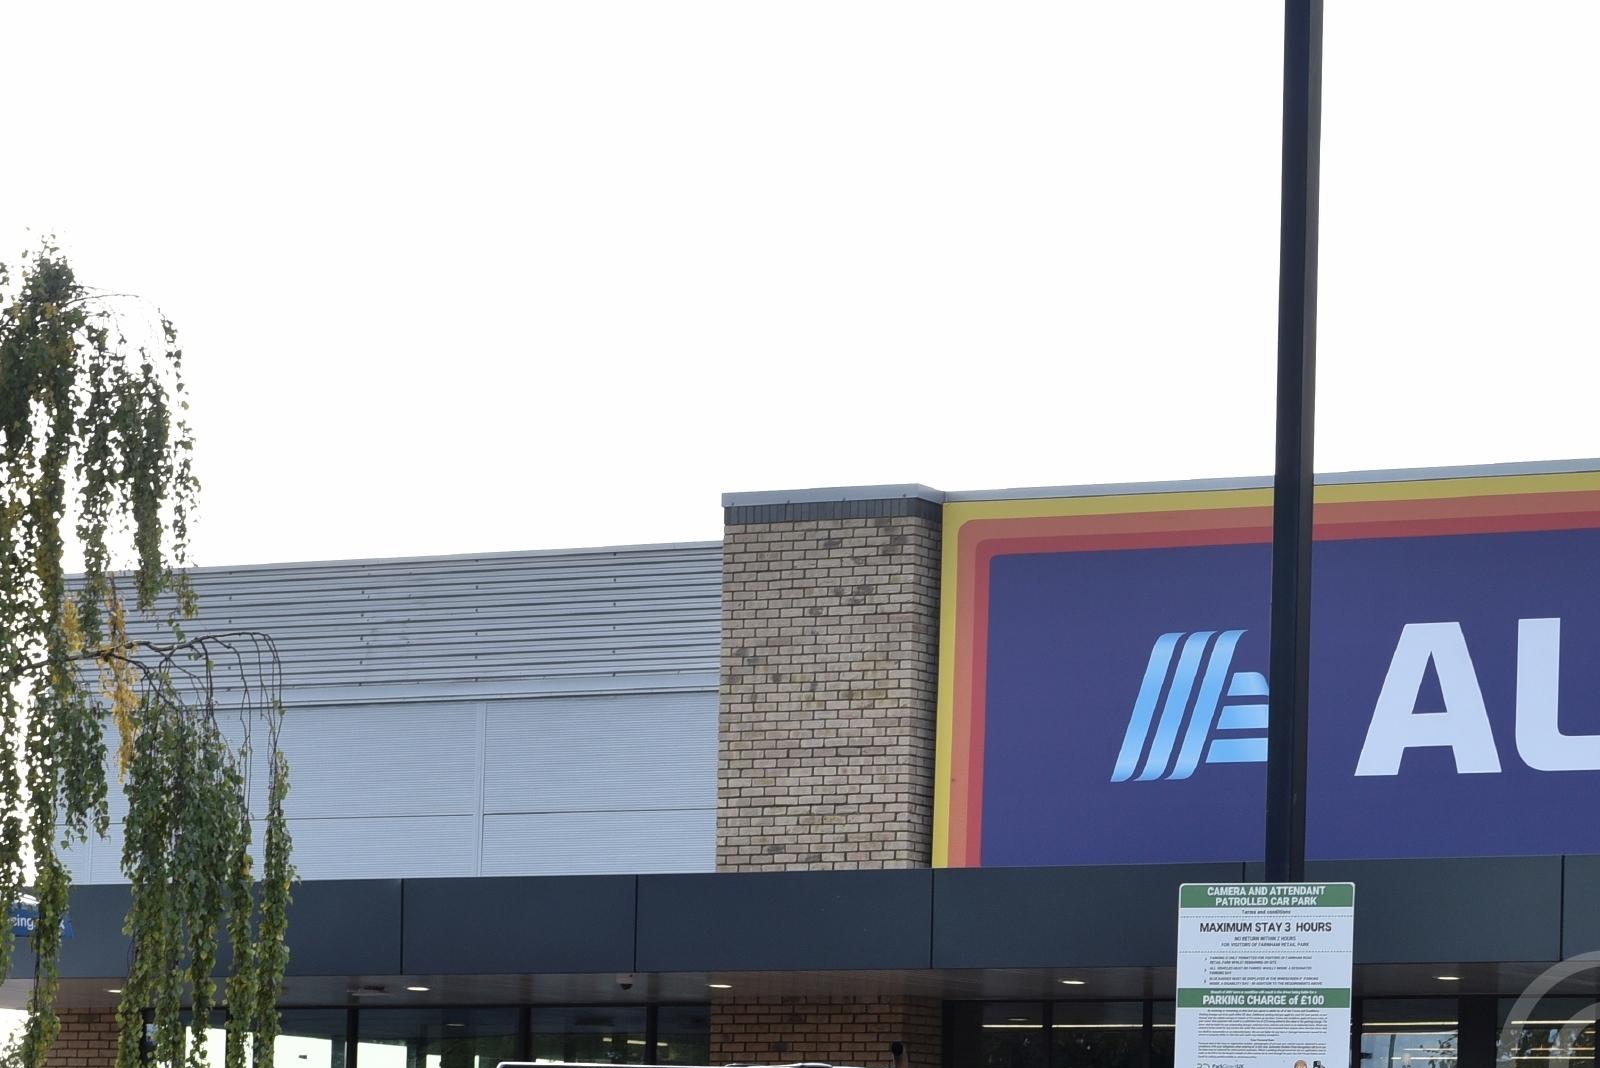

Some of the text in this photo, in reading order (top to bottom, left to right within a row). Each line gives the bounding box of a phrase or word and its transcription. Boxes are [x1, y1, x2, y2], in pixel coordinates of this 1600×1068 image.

[1207, 885, 1326, 896] CAMERA AND ATTENDANT
[1215, 896, 1317, 906] PATROLLED CAR PARK
[1199, 921, 1332, 933] MAXIMUM STAY 3 HOURS
[1202, 994, 1325, 1006] PARKING CHARGE of £100
